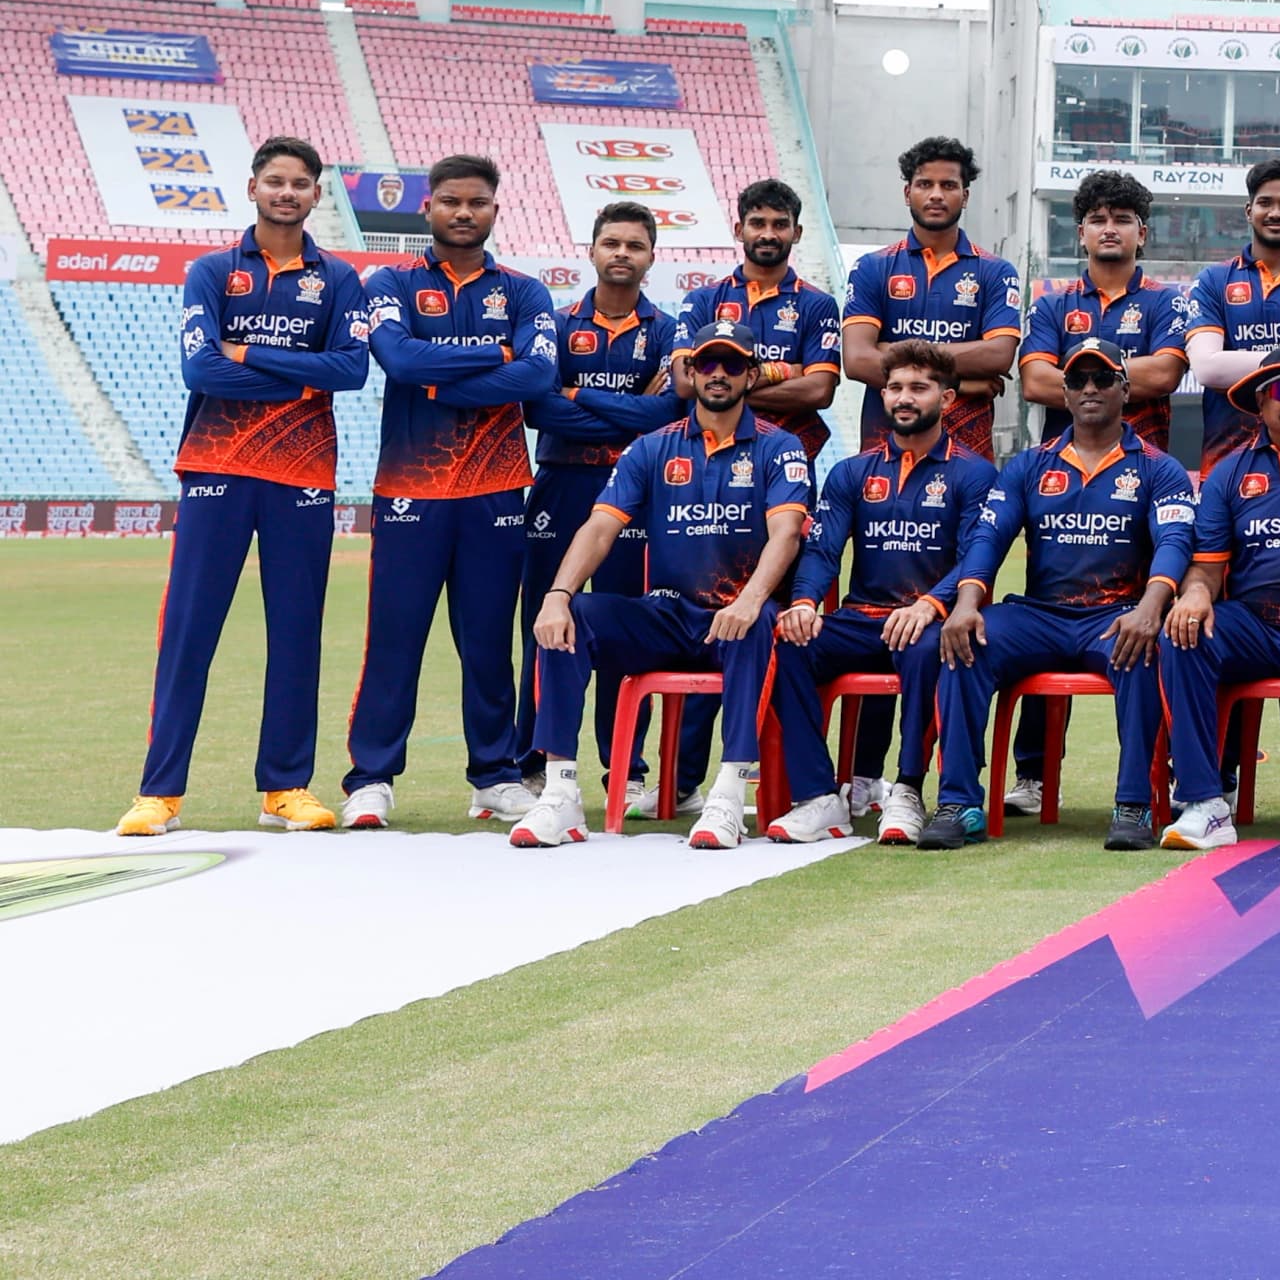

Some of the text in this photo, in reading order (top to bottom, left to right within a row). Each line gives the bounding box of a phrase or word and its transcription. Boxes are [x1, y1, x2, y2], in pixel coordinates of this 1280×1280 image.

[126, 115, 198, 136] 24
[577, 141, 674, 158] NSC
[140, 153, 213, 174] 24
[586, 175, 686, 192] NSC
[1153, 170, 1224, 184] RAYZON
[154, 191, 228, 212] 24
[57, 253, 161, 273] adani ACC
[540, 268, 581, 286] NSC
[619, 527, 648, 539] JKTYL
[1057, 533, 1109, 545] cement
